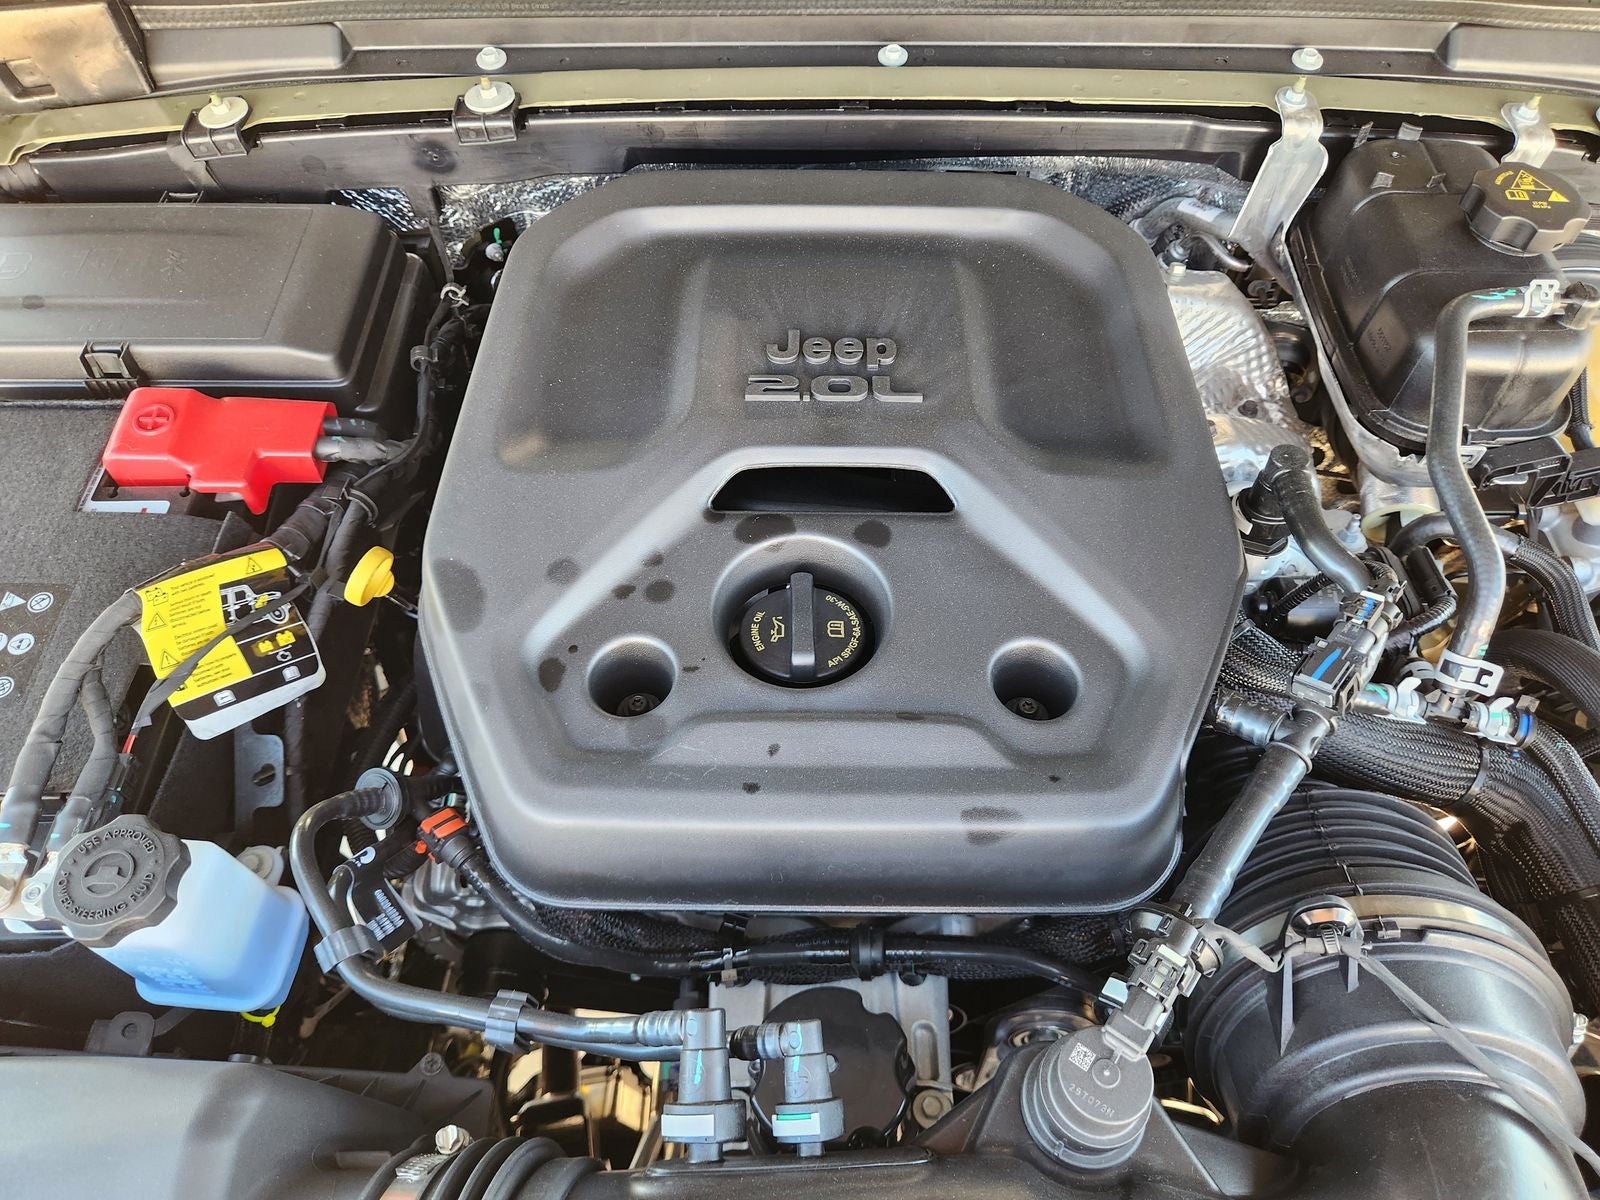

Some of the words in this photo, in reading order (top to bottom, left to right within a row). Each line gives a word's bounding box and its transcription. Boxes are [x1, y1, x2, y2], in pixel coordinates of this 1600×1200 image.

[766, 330, 897, 370] Jeep
[744, 374, 923, 403] 2.0L
[754, 610, 766, 622] OIL
[751, 623, 766, 652] ENGINE
[828, 656, 845, 668] API
[78, 835, 101, 854] USE
[103, 828, 157, 854] APPROVED
[58, 870, 75, 909] POWER
[70, 901, 128, 920] STEERING
[130, 872, 156, 902] FLUID
